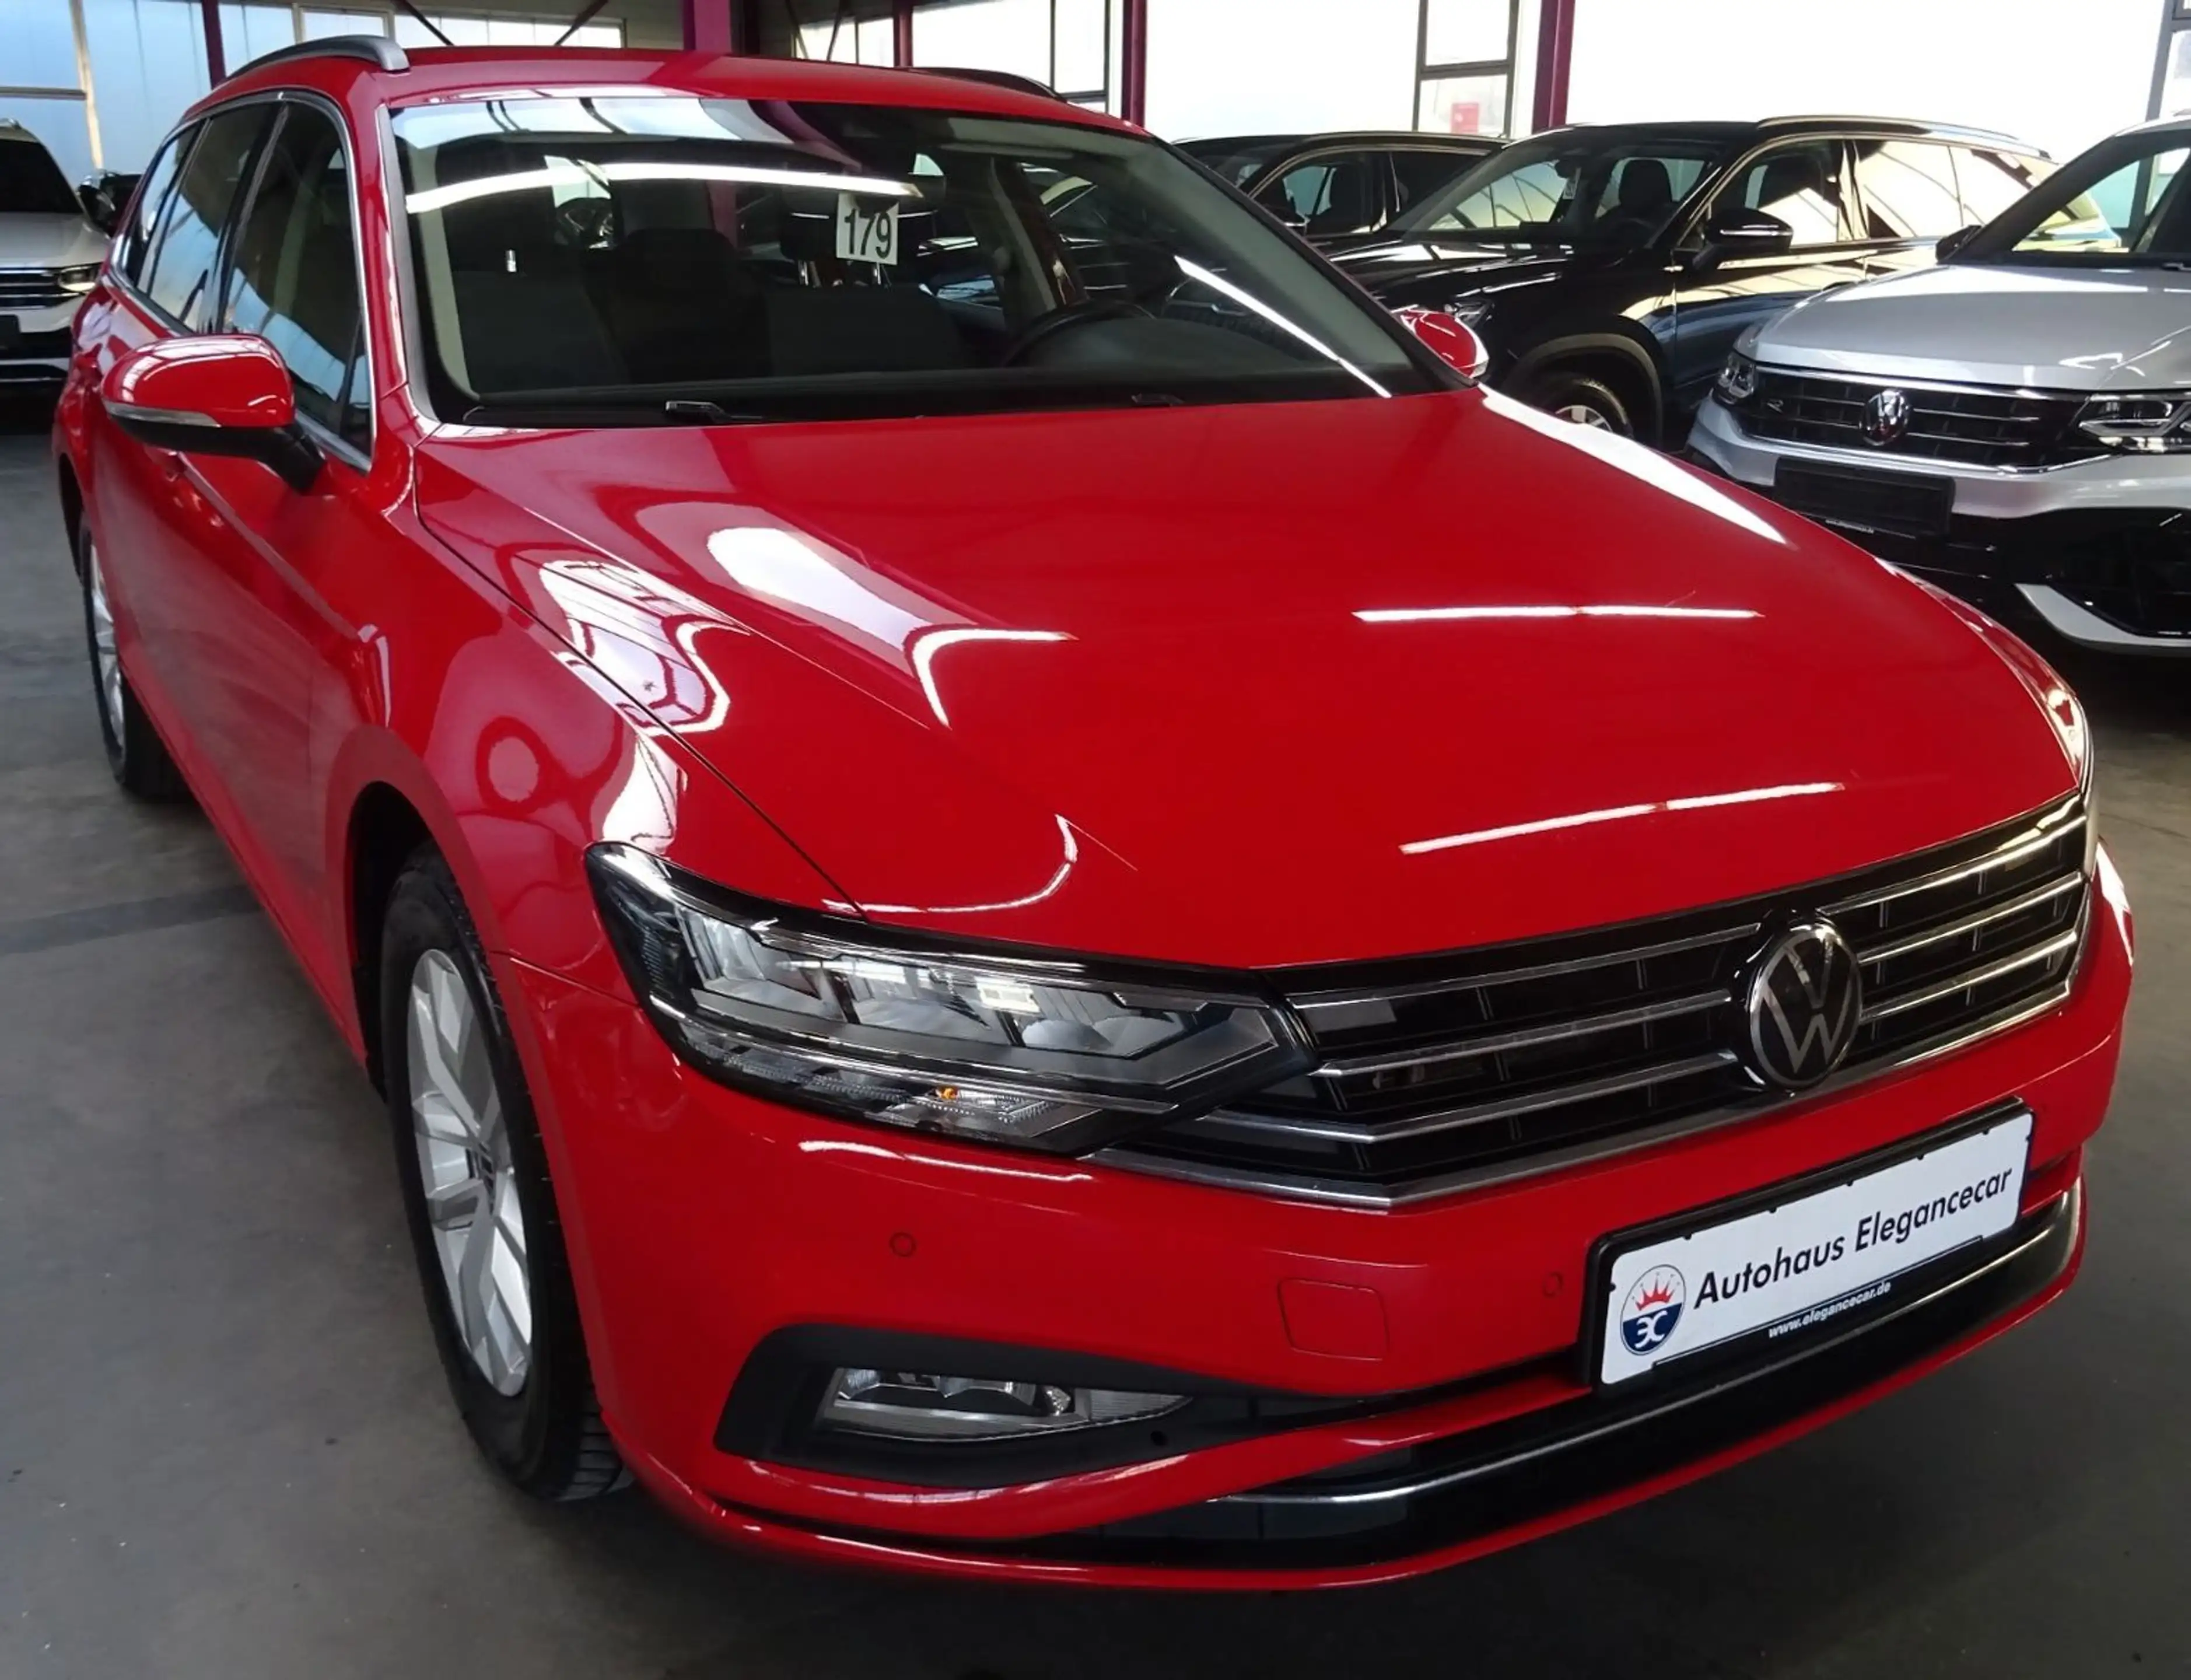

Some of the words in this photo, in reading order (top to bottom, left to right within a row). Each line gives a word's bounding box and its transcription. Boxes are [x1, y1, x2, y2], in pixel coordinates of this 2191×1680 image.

[844, 208, 891, 259] 179
[1693, 1237, 1844, 1309] Autohaus
[1854, 1167, 2013, 1252] Elegancecar
[1769, 1281, 1891, 1339] www.elegancecar.de
